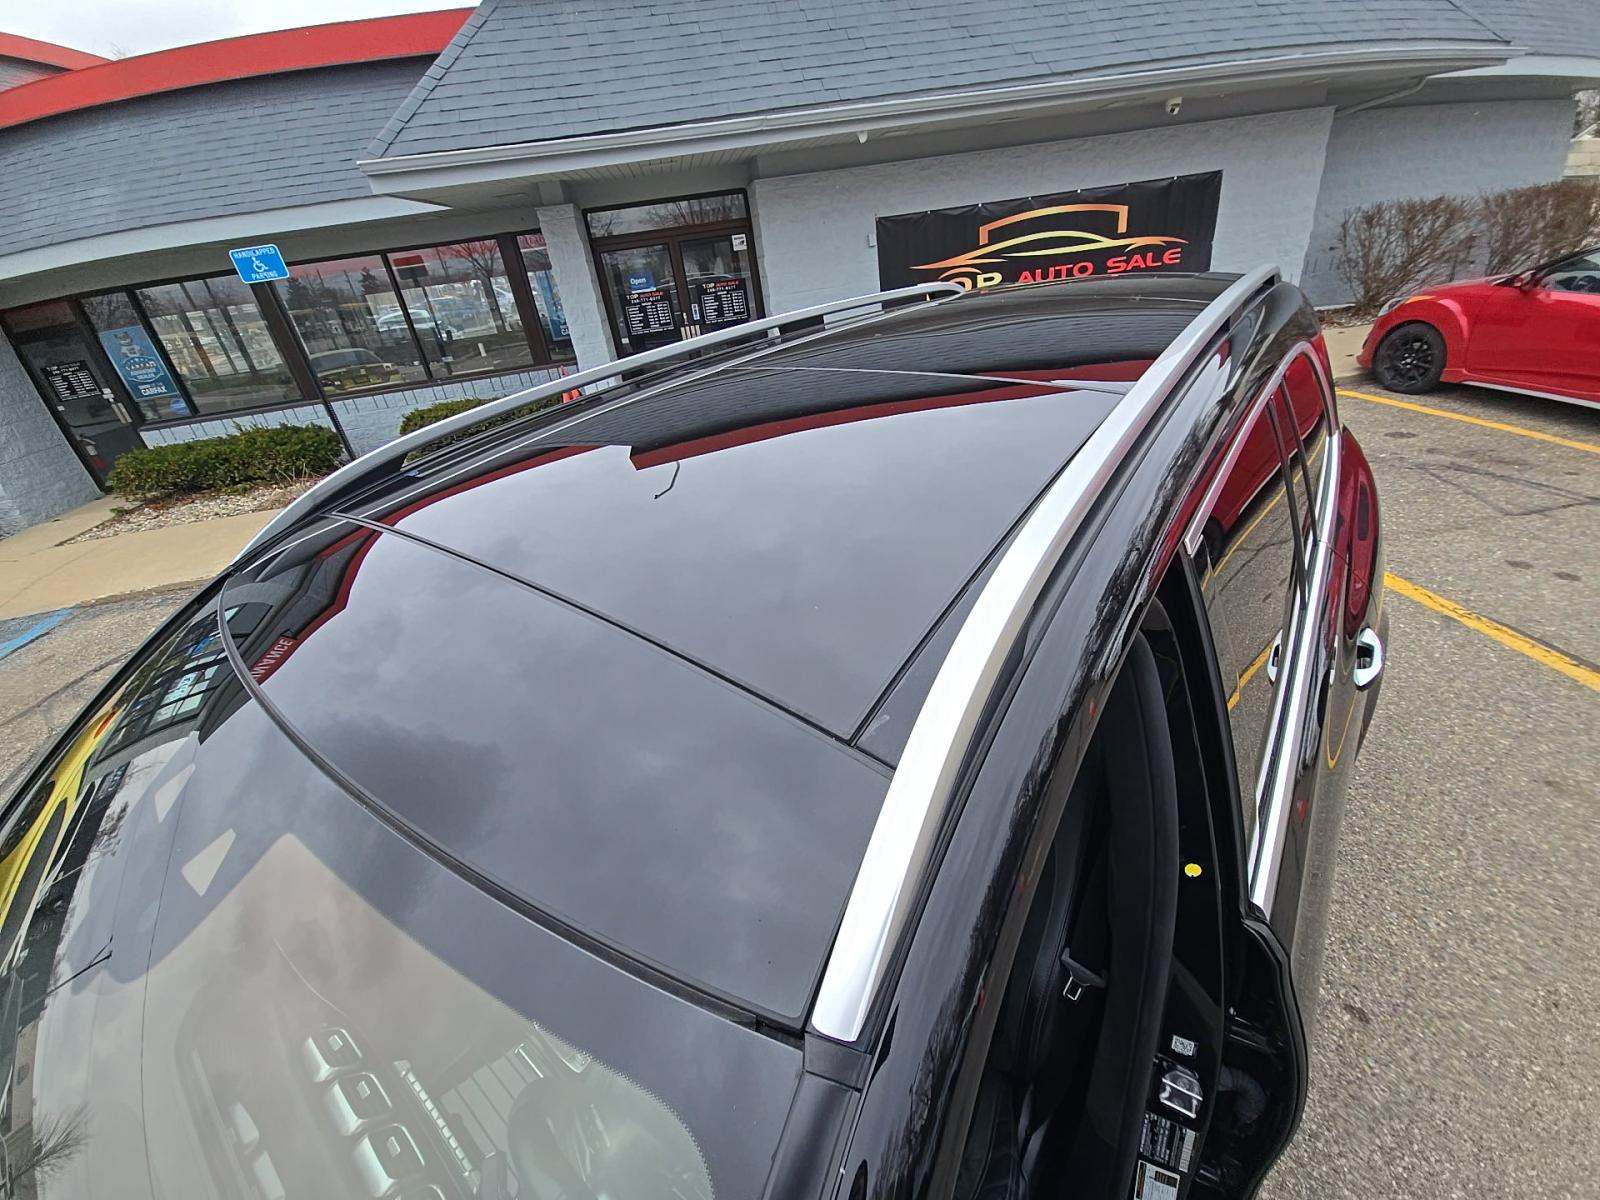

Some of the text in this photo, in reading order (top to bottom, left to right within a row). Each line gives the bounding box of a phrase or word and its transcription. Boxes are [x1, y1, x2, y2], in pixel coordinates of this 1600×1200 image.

[232, 246, 276, 258] HANDICAPPED
[1017, 261, 1094, 283] AUTO
[1106, 248, 1182, 273] SALE
[251, 270, 279, 280] PARKING
[630, 277, 647, 286] Open
[703, 282, 716, 290] TOP
[141, 385, 168, 396] CARFAX
